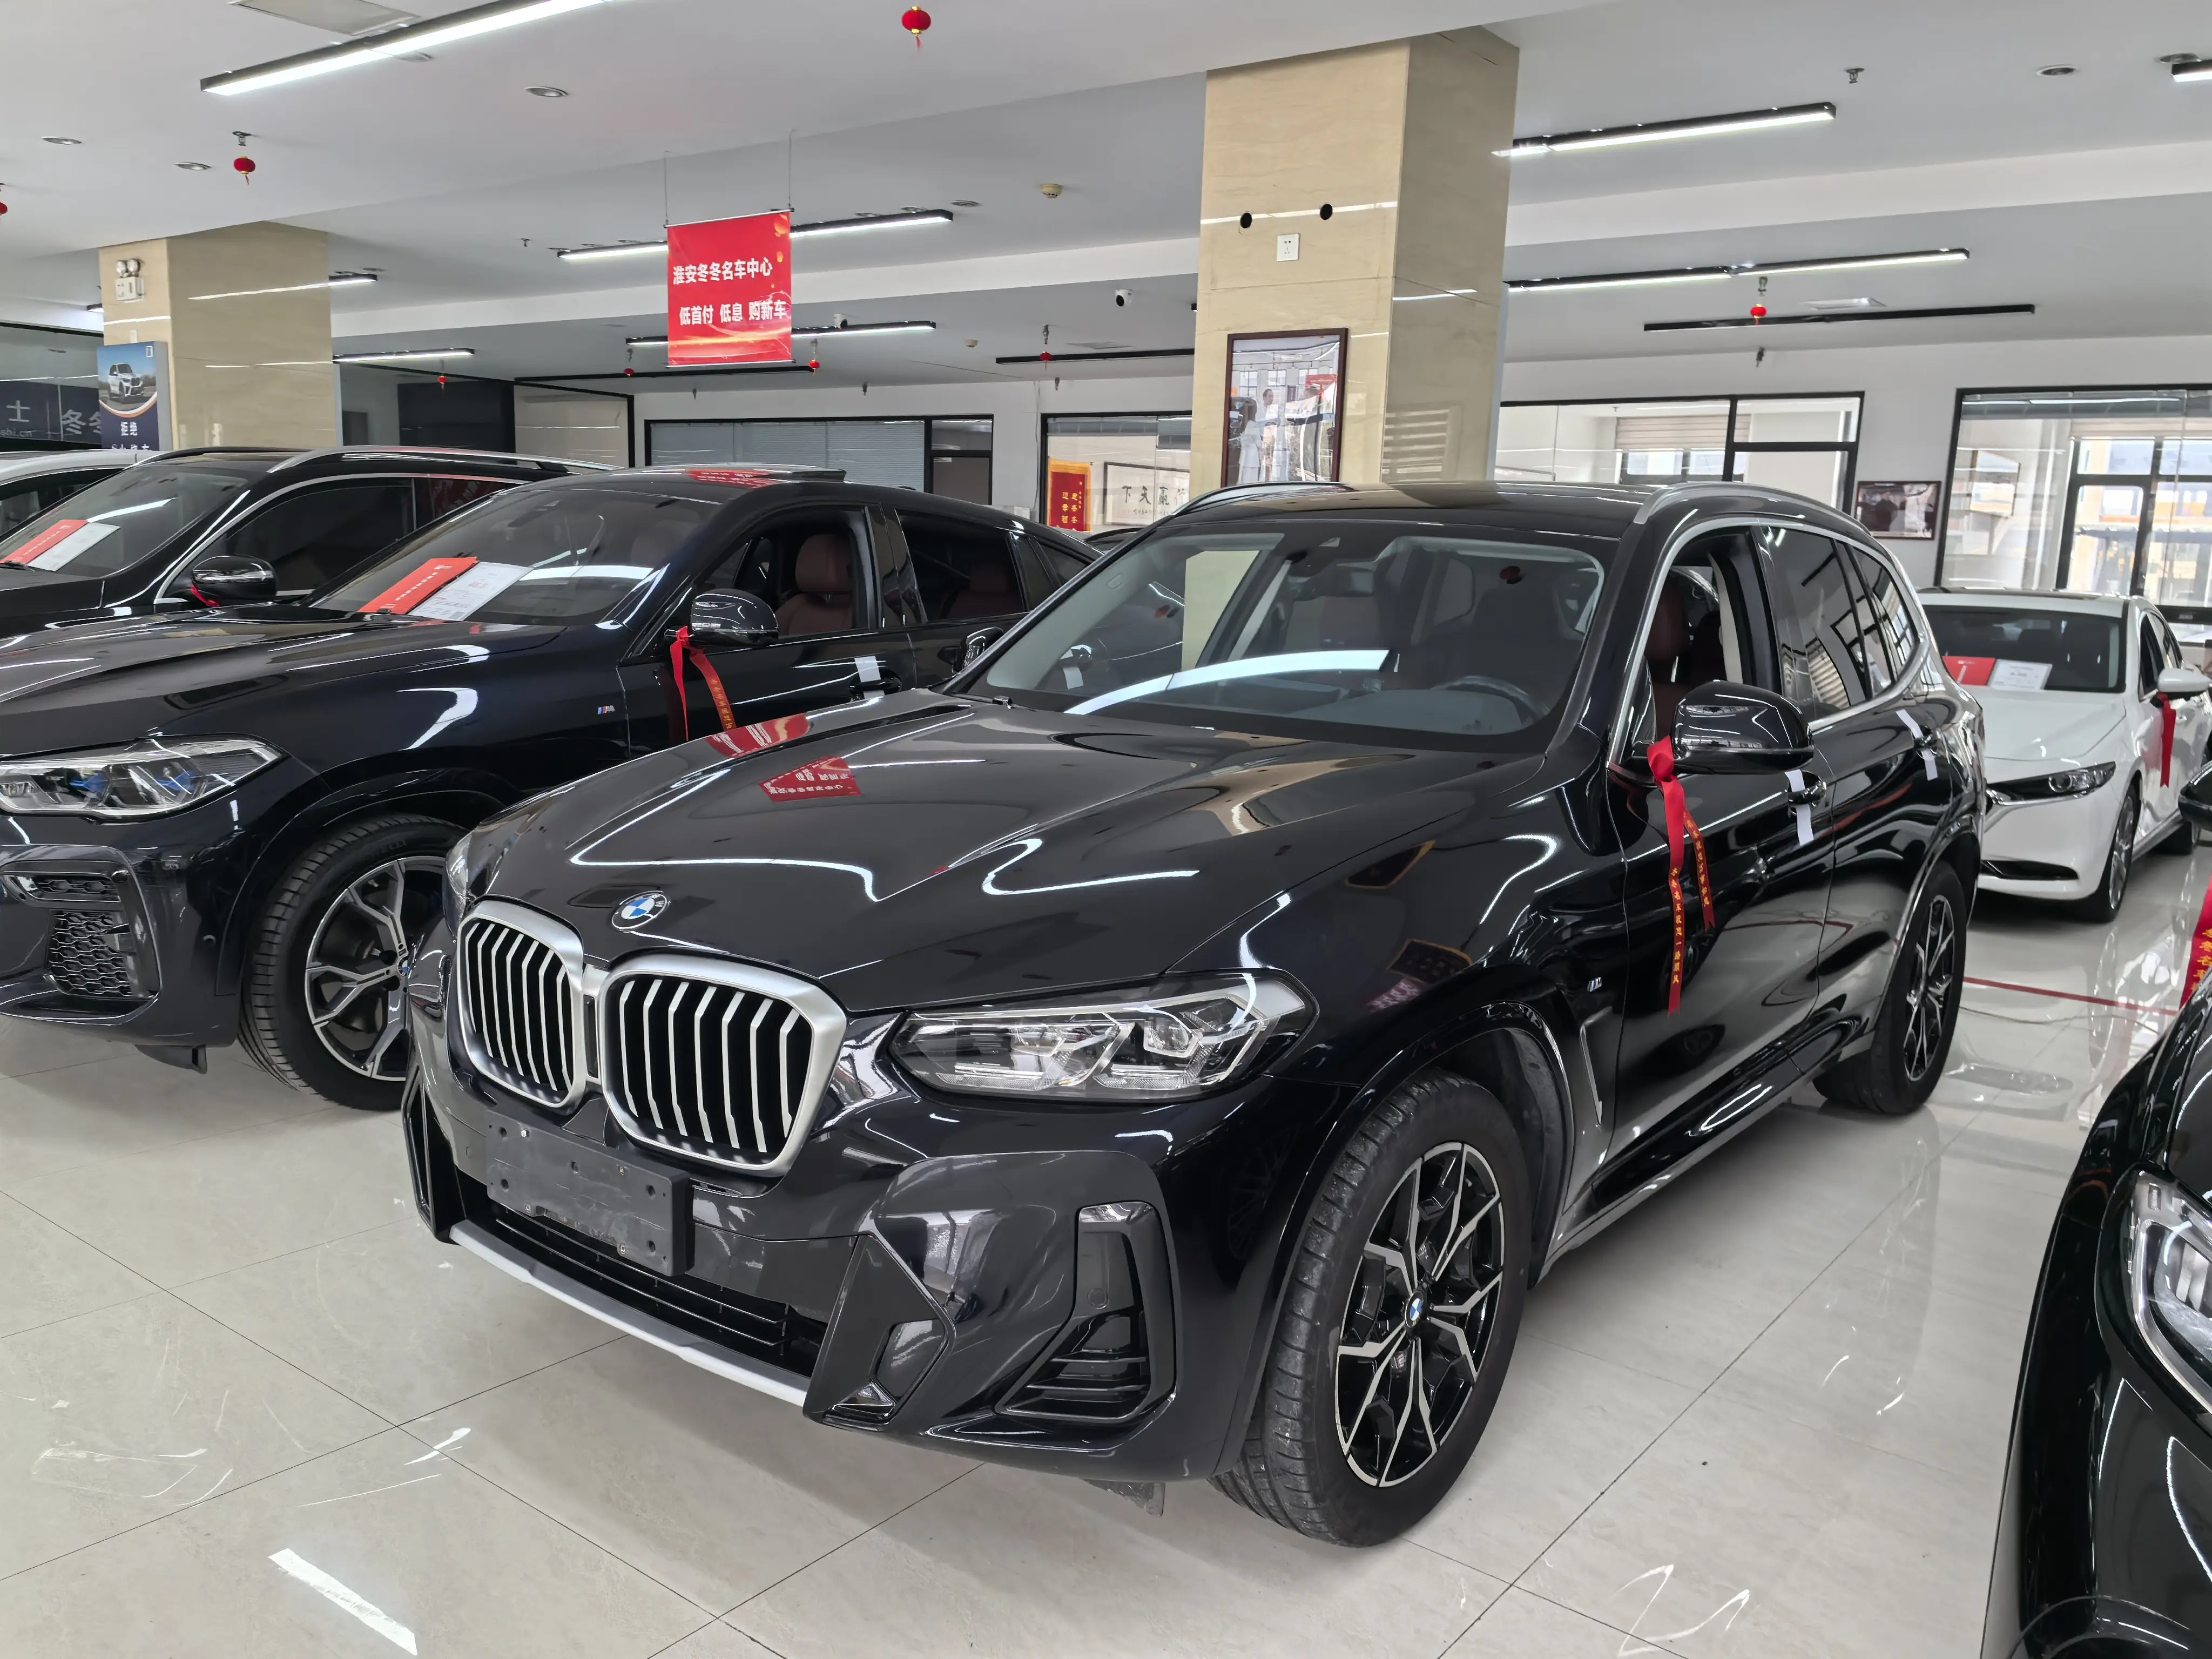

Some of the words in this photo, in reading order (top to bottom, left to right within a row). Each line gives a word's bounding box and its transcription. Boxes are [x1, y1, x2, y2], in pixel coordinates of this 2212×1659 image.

[673, 257, 773, 285] 淮安冬冬名车中心
[679, 305, 714, 326] 低首付
[719, 303, 743, 323] 低息
[748, 299, 788, 321] 购新车
